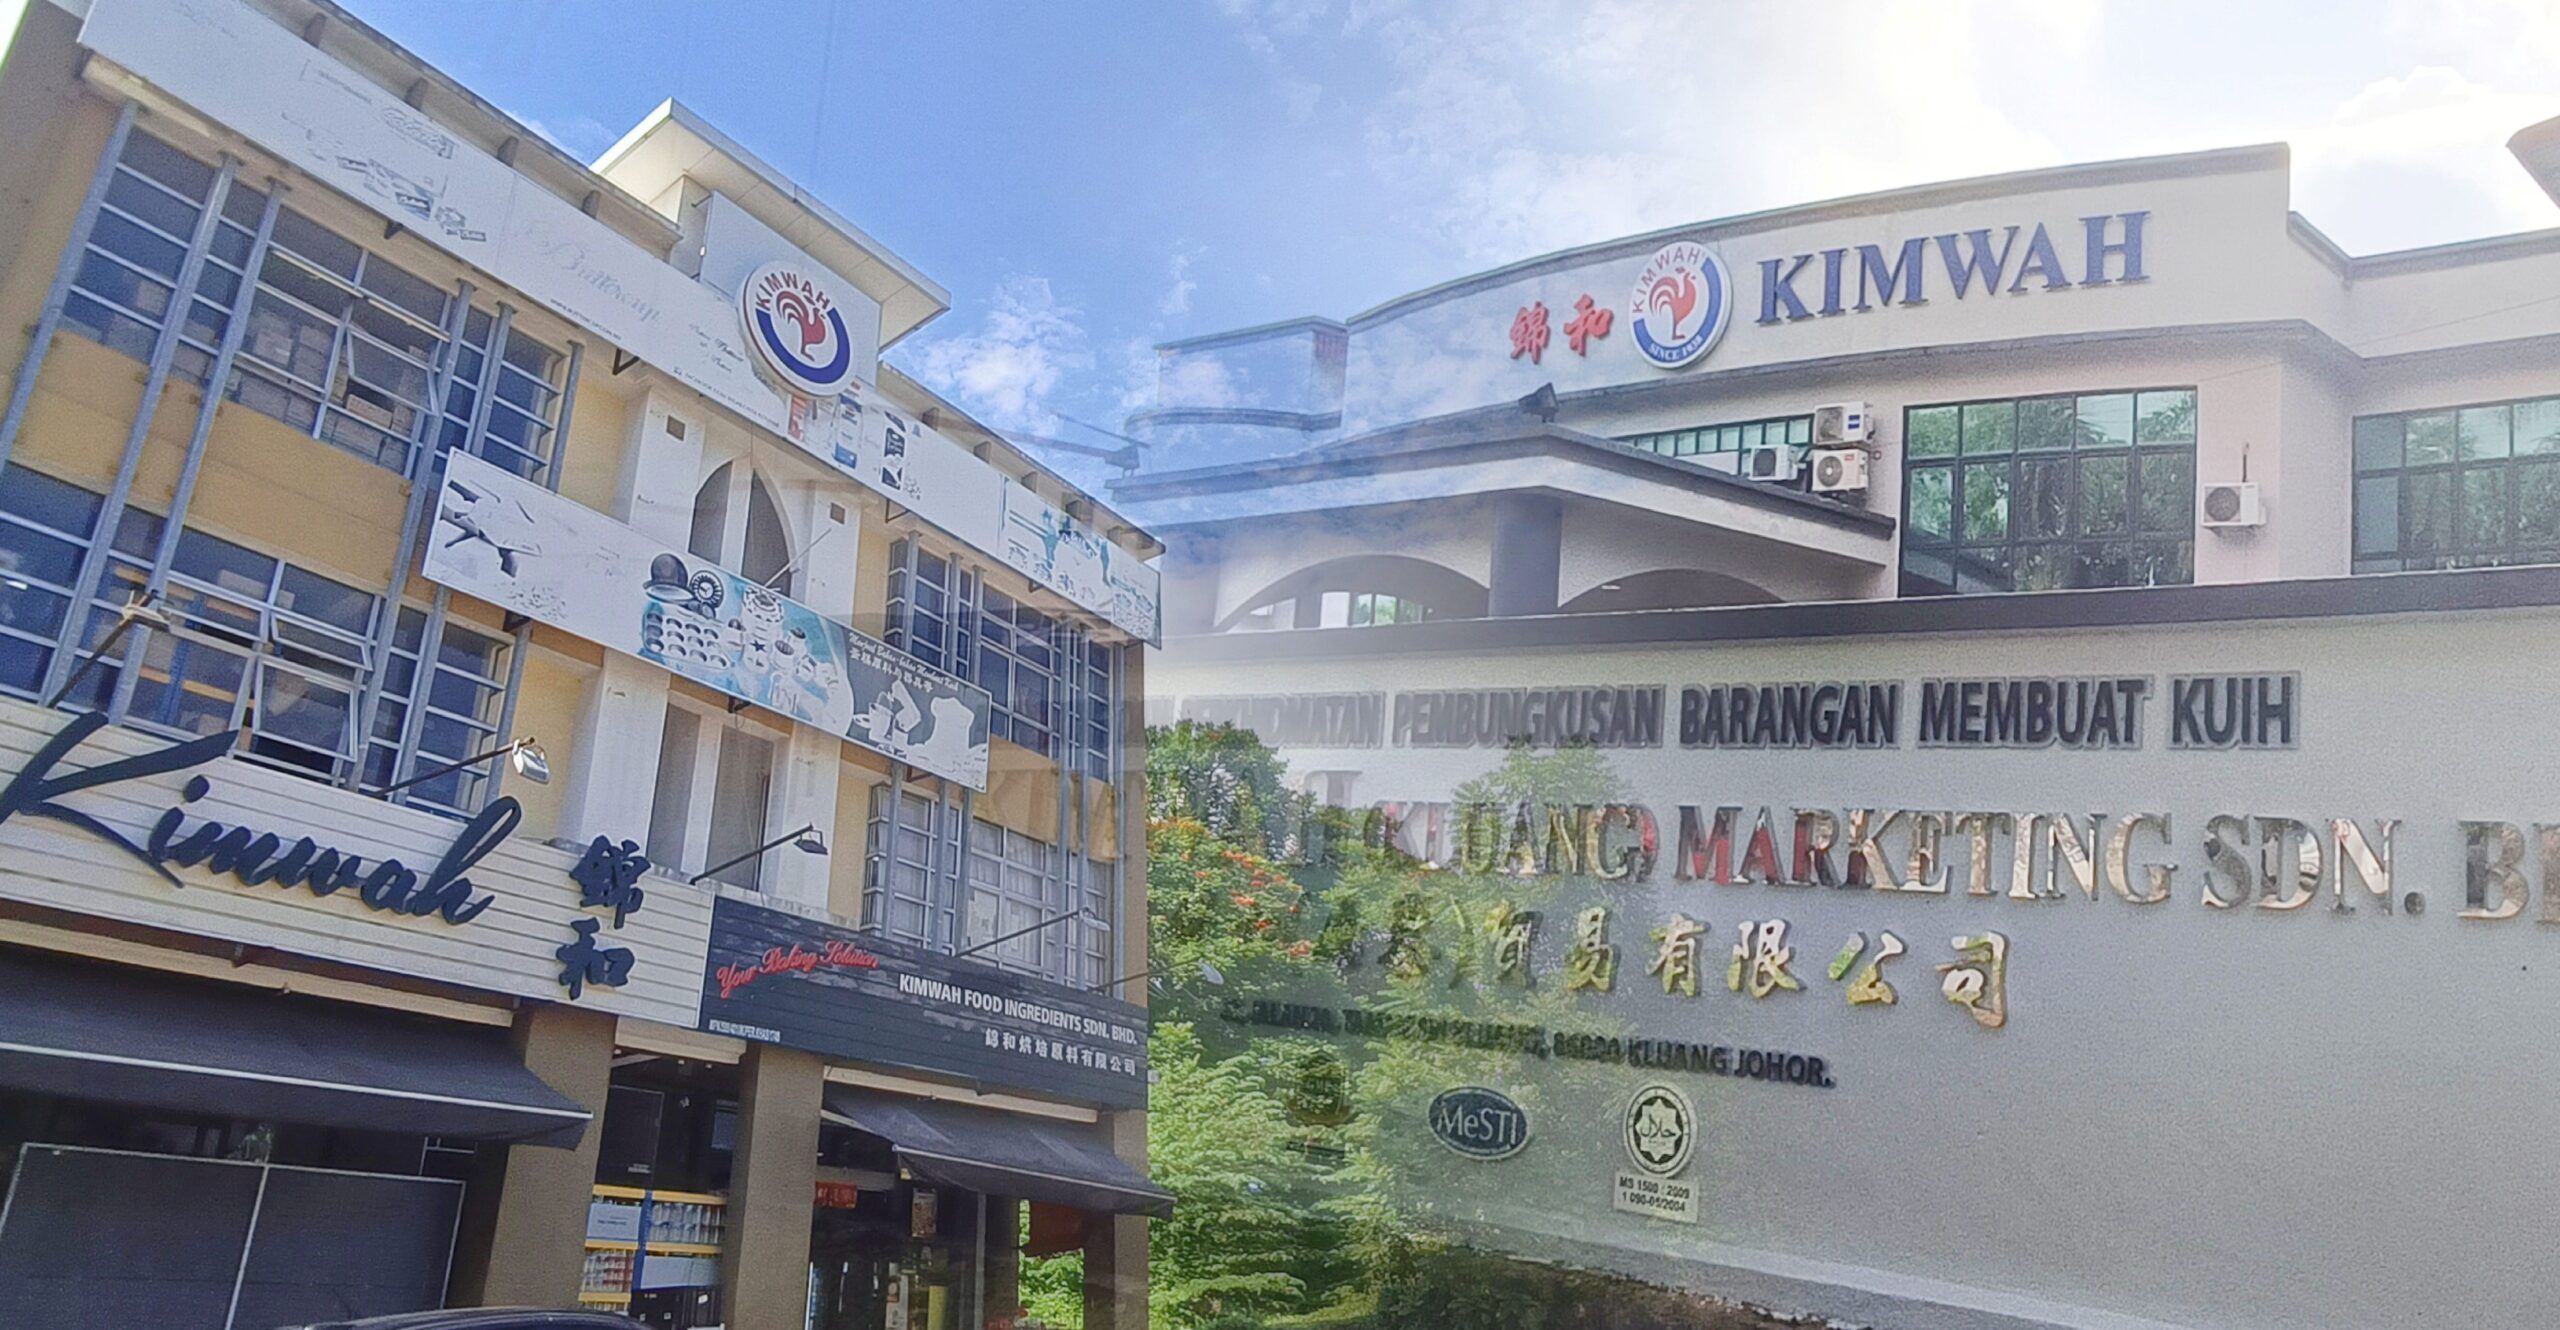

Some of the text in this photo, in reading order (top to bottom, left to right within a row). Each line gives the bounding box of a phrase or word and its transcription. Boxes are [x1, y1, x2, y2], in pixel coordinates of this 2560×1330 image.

[755, 270, 831, 312] KIMWAH
[1632, 247, 1699, 314] KIMWAH
[1755, 211, 2150, 325] KIMWAH
[1509, 294, 1614, 365] 錦和
[1649, 342, 1681, 362] SINCE
[1394, 685, 1665, 748] PEMBUNGKUSAN
[1680, 681, 1899, 748] BARANGAN
[1918, 677, 2148, 748] MEMBUAT
[2171, 673, 2294, 746] KUIH
[0, 709, 522, 926] Kimwah
[1675, 805, 2178, 903] MARKETING
[2201, 814, 2428, 916] SDN.
[716, 941, 881, 1001] Your Baking Solution
[899, 973, 1138, 1046] KIMWAH FOOD INGREDIENTS SDN. BHD.
[1626, 1037, 1728, 1077] KLUANG
[1733, 1049, 1837, 1089] JOHOR.
[1437, 1103, 1518, 1145] MeSTI
[1619, 1176, 1635, 1189] MS
[1637, 1179, 1660, 1195] 1500
